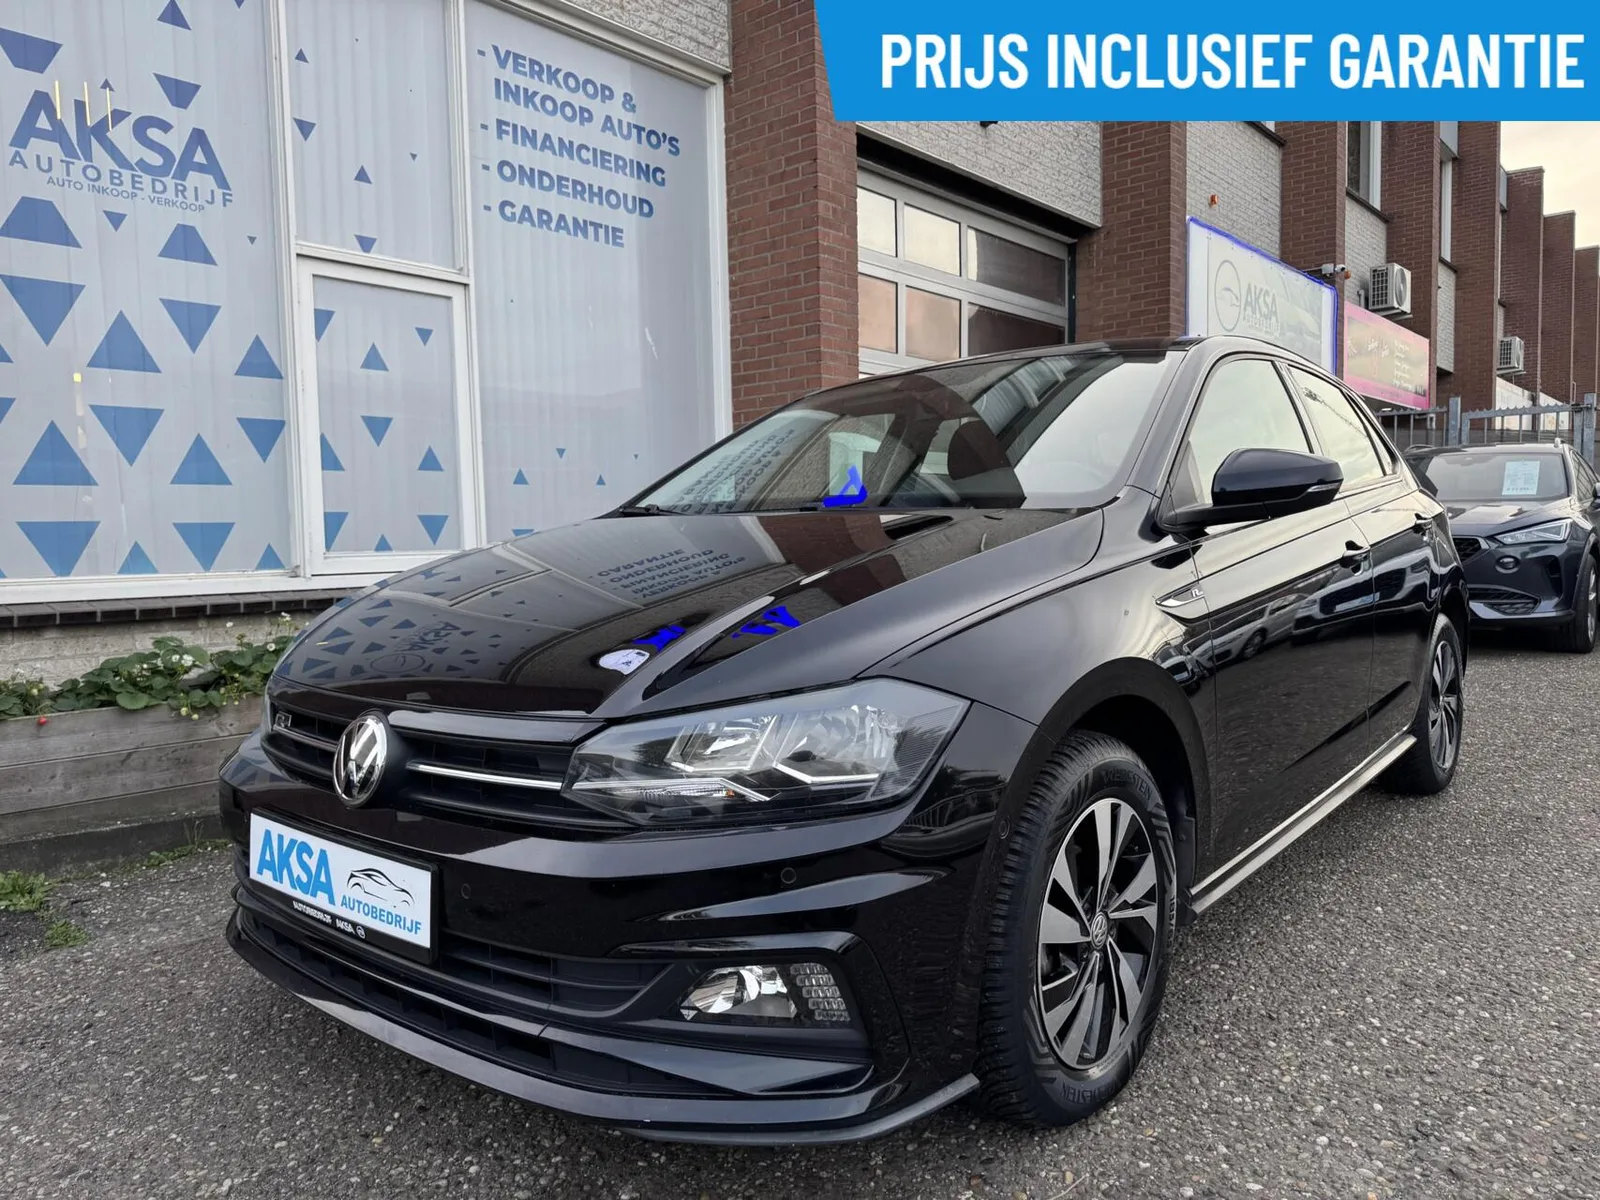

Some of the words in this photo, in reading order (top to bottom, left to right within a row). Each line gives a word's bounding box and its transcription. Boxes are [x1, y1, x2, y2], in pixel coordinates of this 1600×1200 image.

[492, 44, 614, 103] VERKOOP
[622, 92, 636, 113] &
[9, 90, 231, 191] AKSA
[494, 78, 593, 126] INKOOP
[601, 115, 680, 156] AUTO'S
[9, 150, 232, 207] AUTOBEDRIJF
[496, 118, 666, 187] FINANCIERING
[47, 176, 83, 190] AUTO
[88, 184, 137, 200] INKOOP
[148, 195, 204, 213] VERKOOP
[497, 160, 653, 218] ONDERHOUD
[498, 200, 624, 248] GARANTIE
[1243, 282, 1279, 323] AKSA
[257, 829, 335, 906] AKSA
[341, 895, 422, 935] AUTOBEDRIJF
